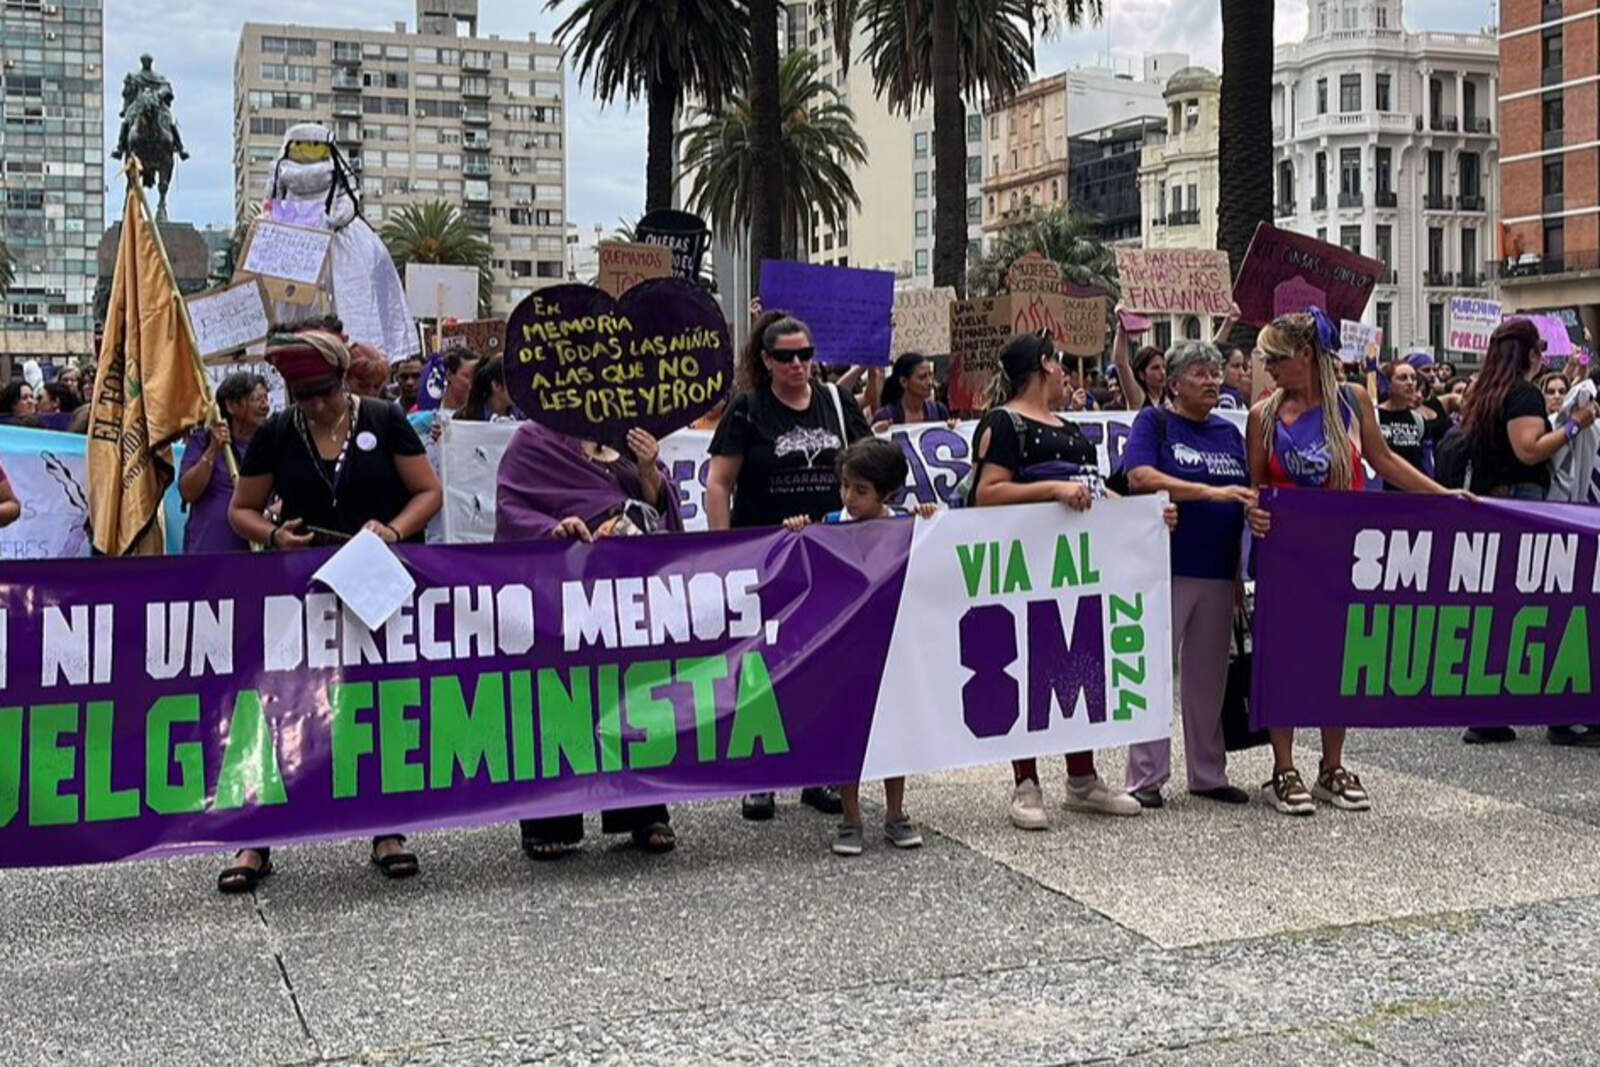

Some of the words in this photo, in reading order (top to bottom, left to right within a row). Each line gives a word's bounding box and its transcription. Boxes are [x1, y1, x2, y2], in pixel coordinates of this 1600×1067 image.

[602, 249, 662, 269] QUEMAMOS
[1189, 271, 1221, 291] NOS
[952, 314, 987, 327] VUELVE
[954, 304, 974, 314] UNA
[982, 300, 994, 311] SE
[519, 345, 546, 363] DE
[549, 336, 622, 366] TODAS
[630, 336, 668, 356] LAS
[952, 326, 997, 339] FEMINISTA
[531, 372, 550, 390] A
[554, 367, 595, 386] LAS
[601, 362, 645, 384] QUE
[658, 355, 699, 381] NO
[539, 389, 583, 411] LES
[584, 370, 723, 424] CREYERON
[92, 418, 122, 444] EL
[956, 539, 1032, 598] VIA
[1051, 532, 1100, 588] AL
[1351, 528, 1433, 592] 8M
[1449, 531, 1501, 593] NI
[1515, 533, 1579, 593] UN
[41, 603, 114, 687] NI
[146, 598, 235, 680] UN
[562, 568, 780, 652] MENOS,
[1340, 603, 1591, 696] HUELGA
[959, 593, 1107, 739] 8M
[1109, 592, 1147, 720] 2024
[330, 650, 790, 799] FEMINISTA
